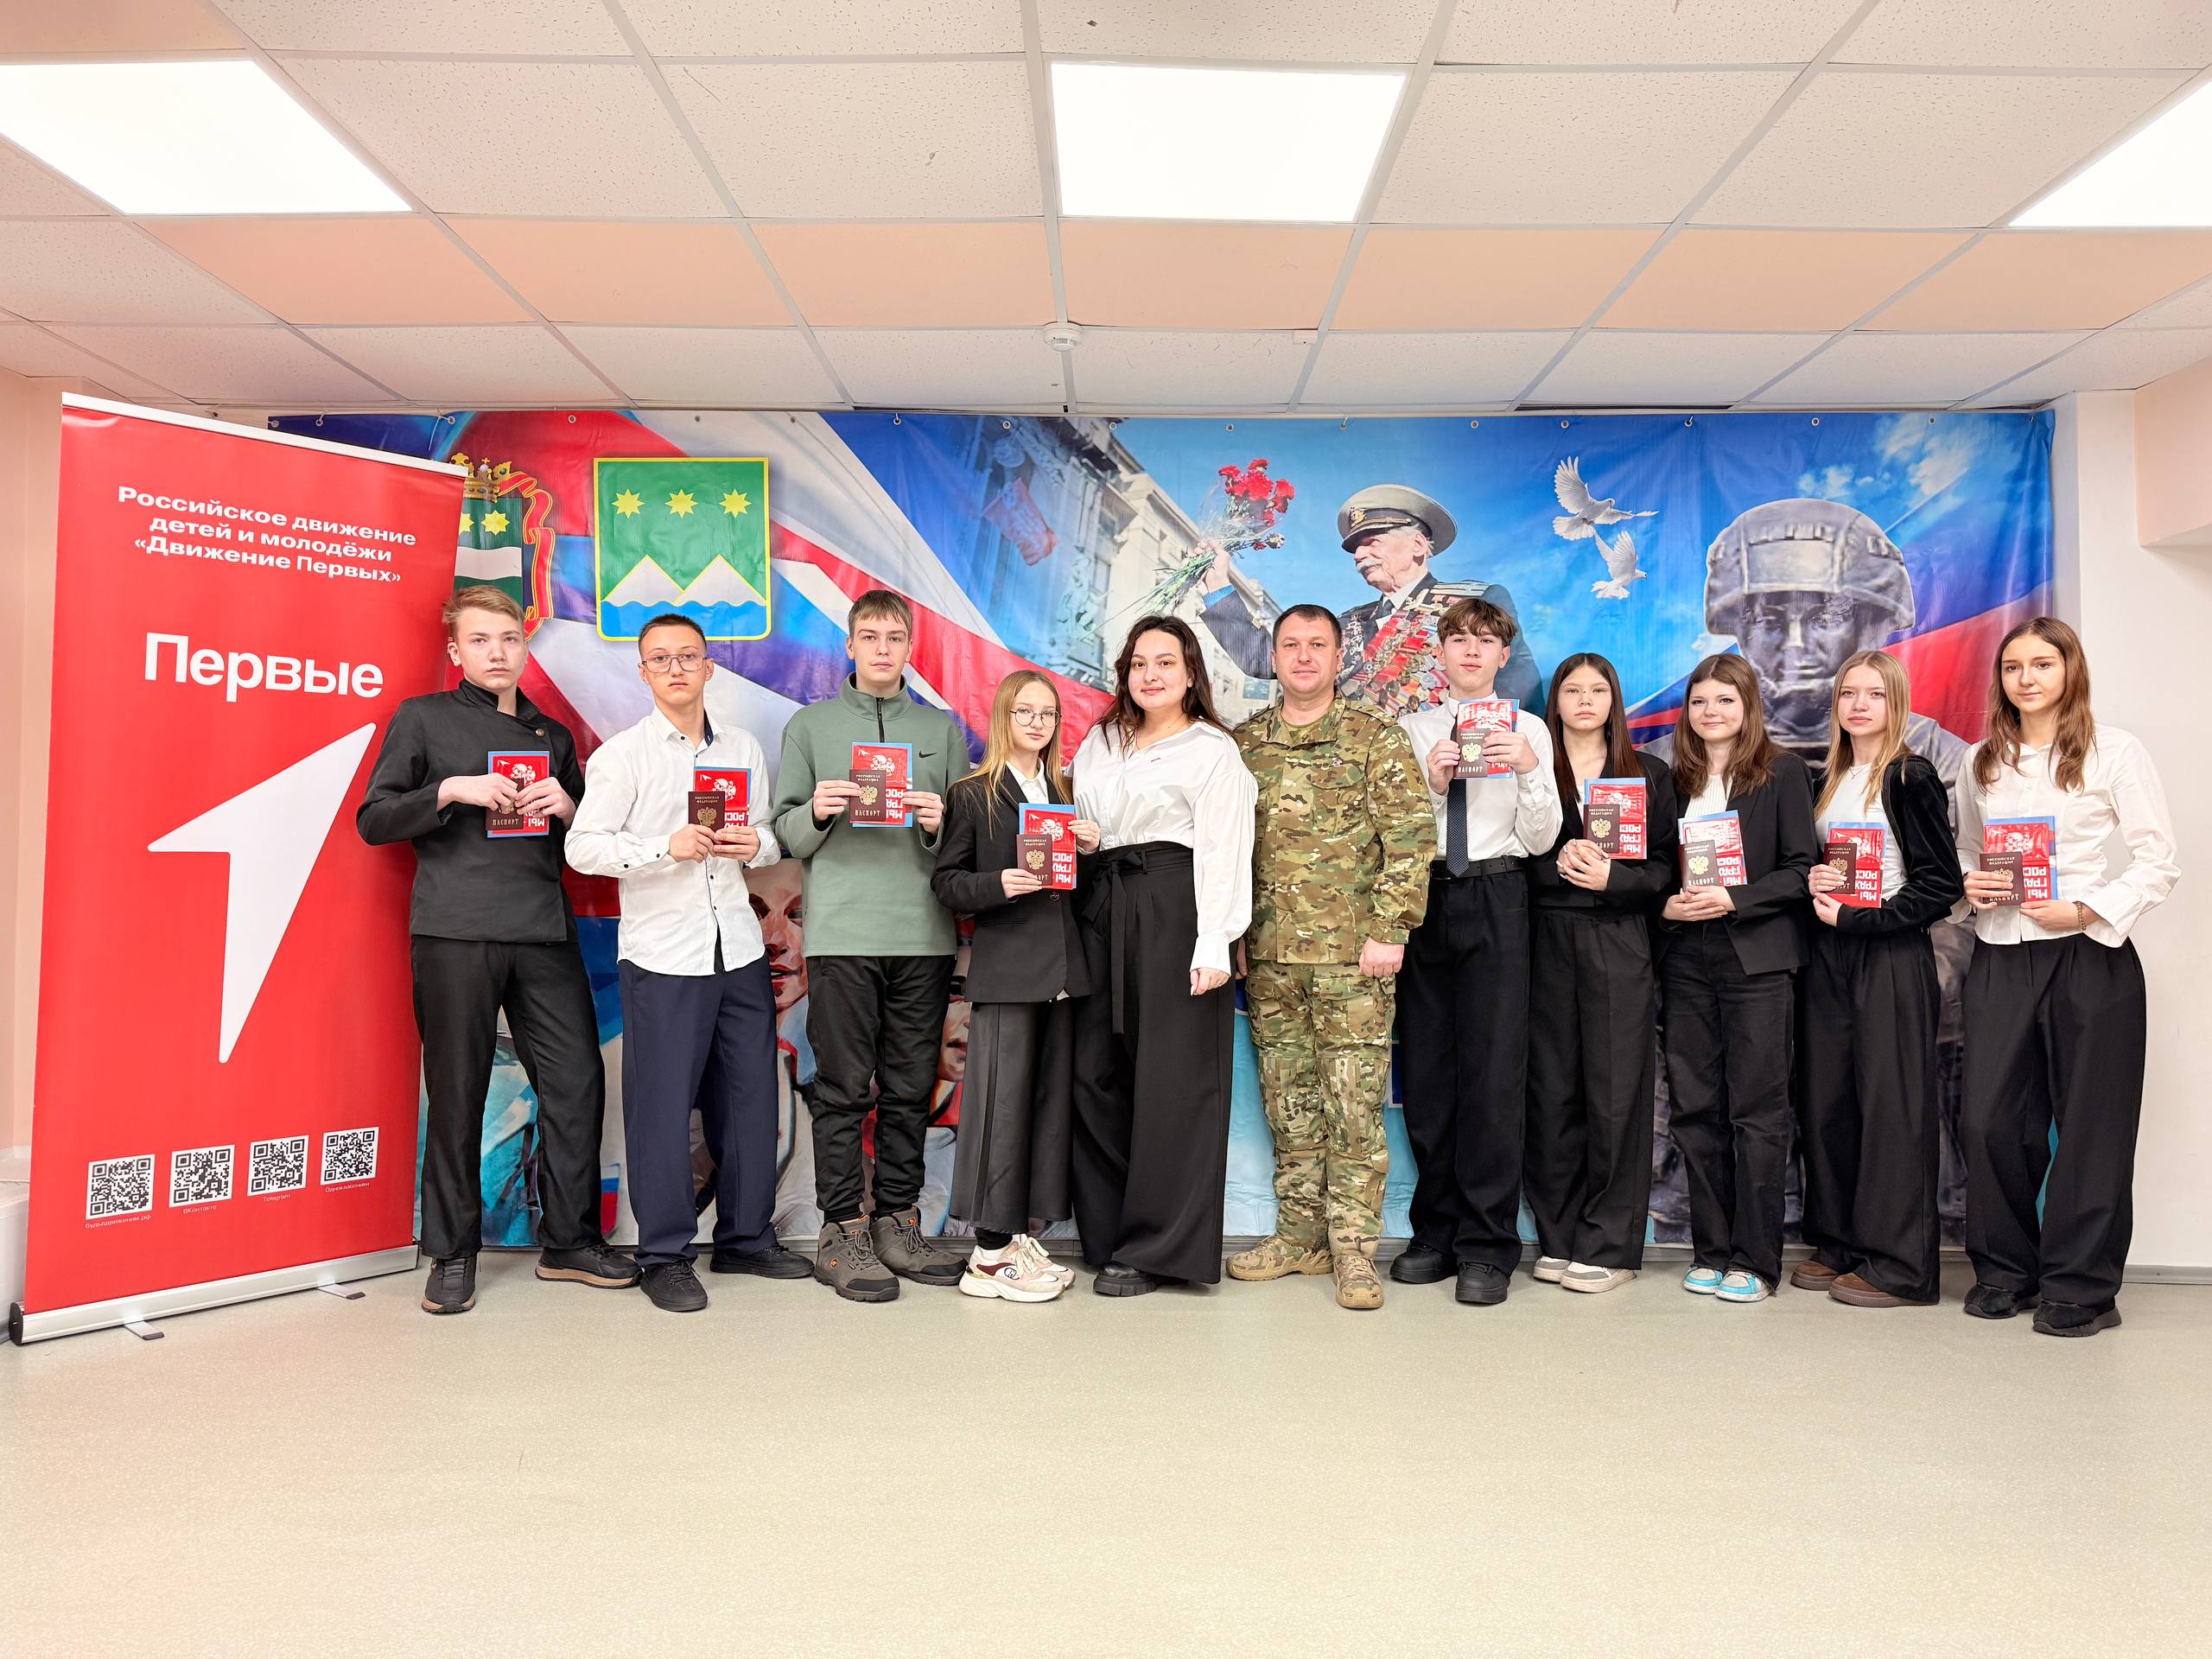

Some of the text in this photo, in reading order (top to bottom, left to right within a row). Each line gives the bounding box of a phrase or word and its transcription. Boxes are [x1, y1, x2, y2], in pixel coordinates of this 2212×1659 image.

[118, 486, 416, 546] Российское движение
[149, 516, 392, 563] детей и молодёжи
[134, 534, 401, 584] «Движение Первых»
[144, 632, 385, 702] Первые
[528, 817, 545, 827] МЫ
[1624, 843, 1641, 854] МЫ
[1055, 874, 1071, 884] МЫ
[1688, 877, 1714, 887] ПАСПОРТ
[1859, 891, 1877, 901] МЫ
[2027, 888, 2048, 899] МЫ
[325, 1182, 370, 1193] Одноклассники
[263, 1193, 290, 1202] Telegram
[182, 1205, 218, 1214] ВКонтакте
